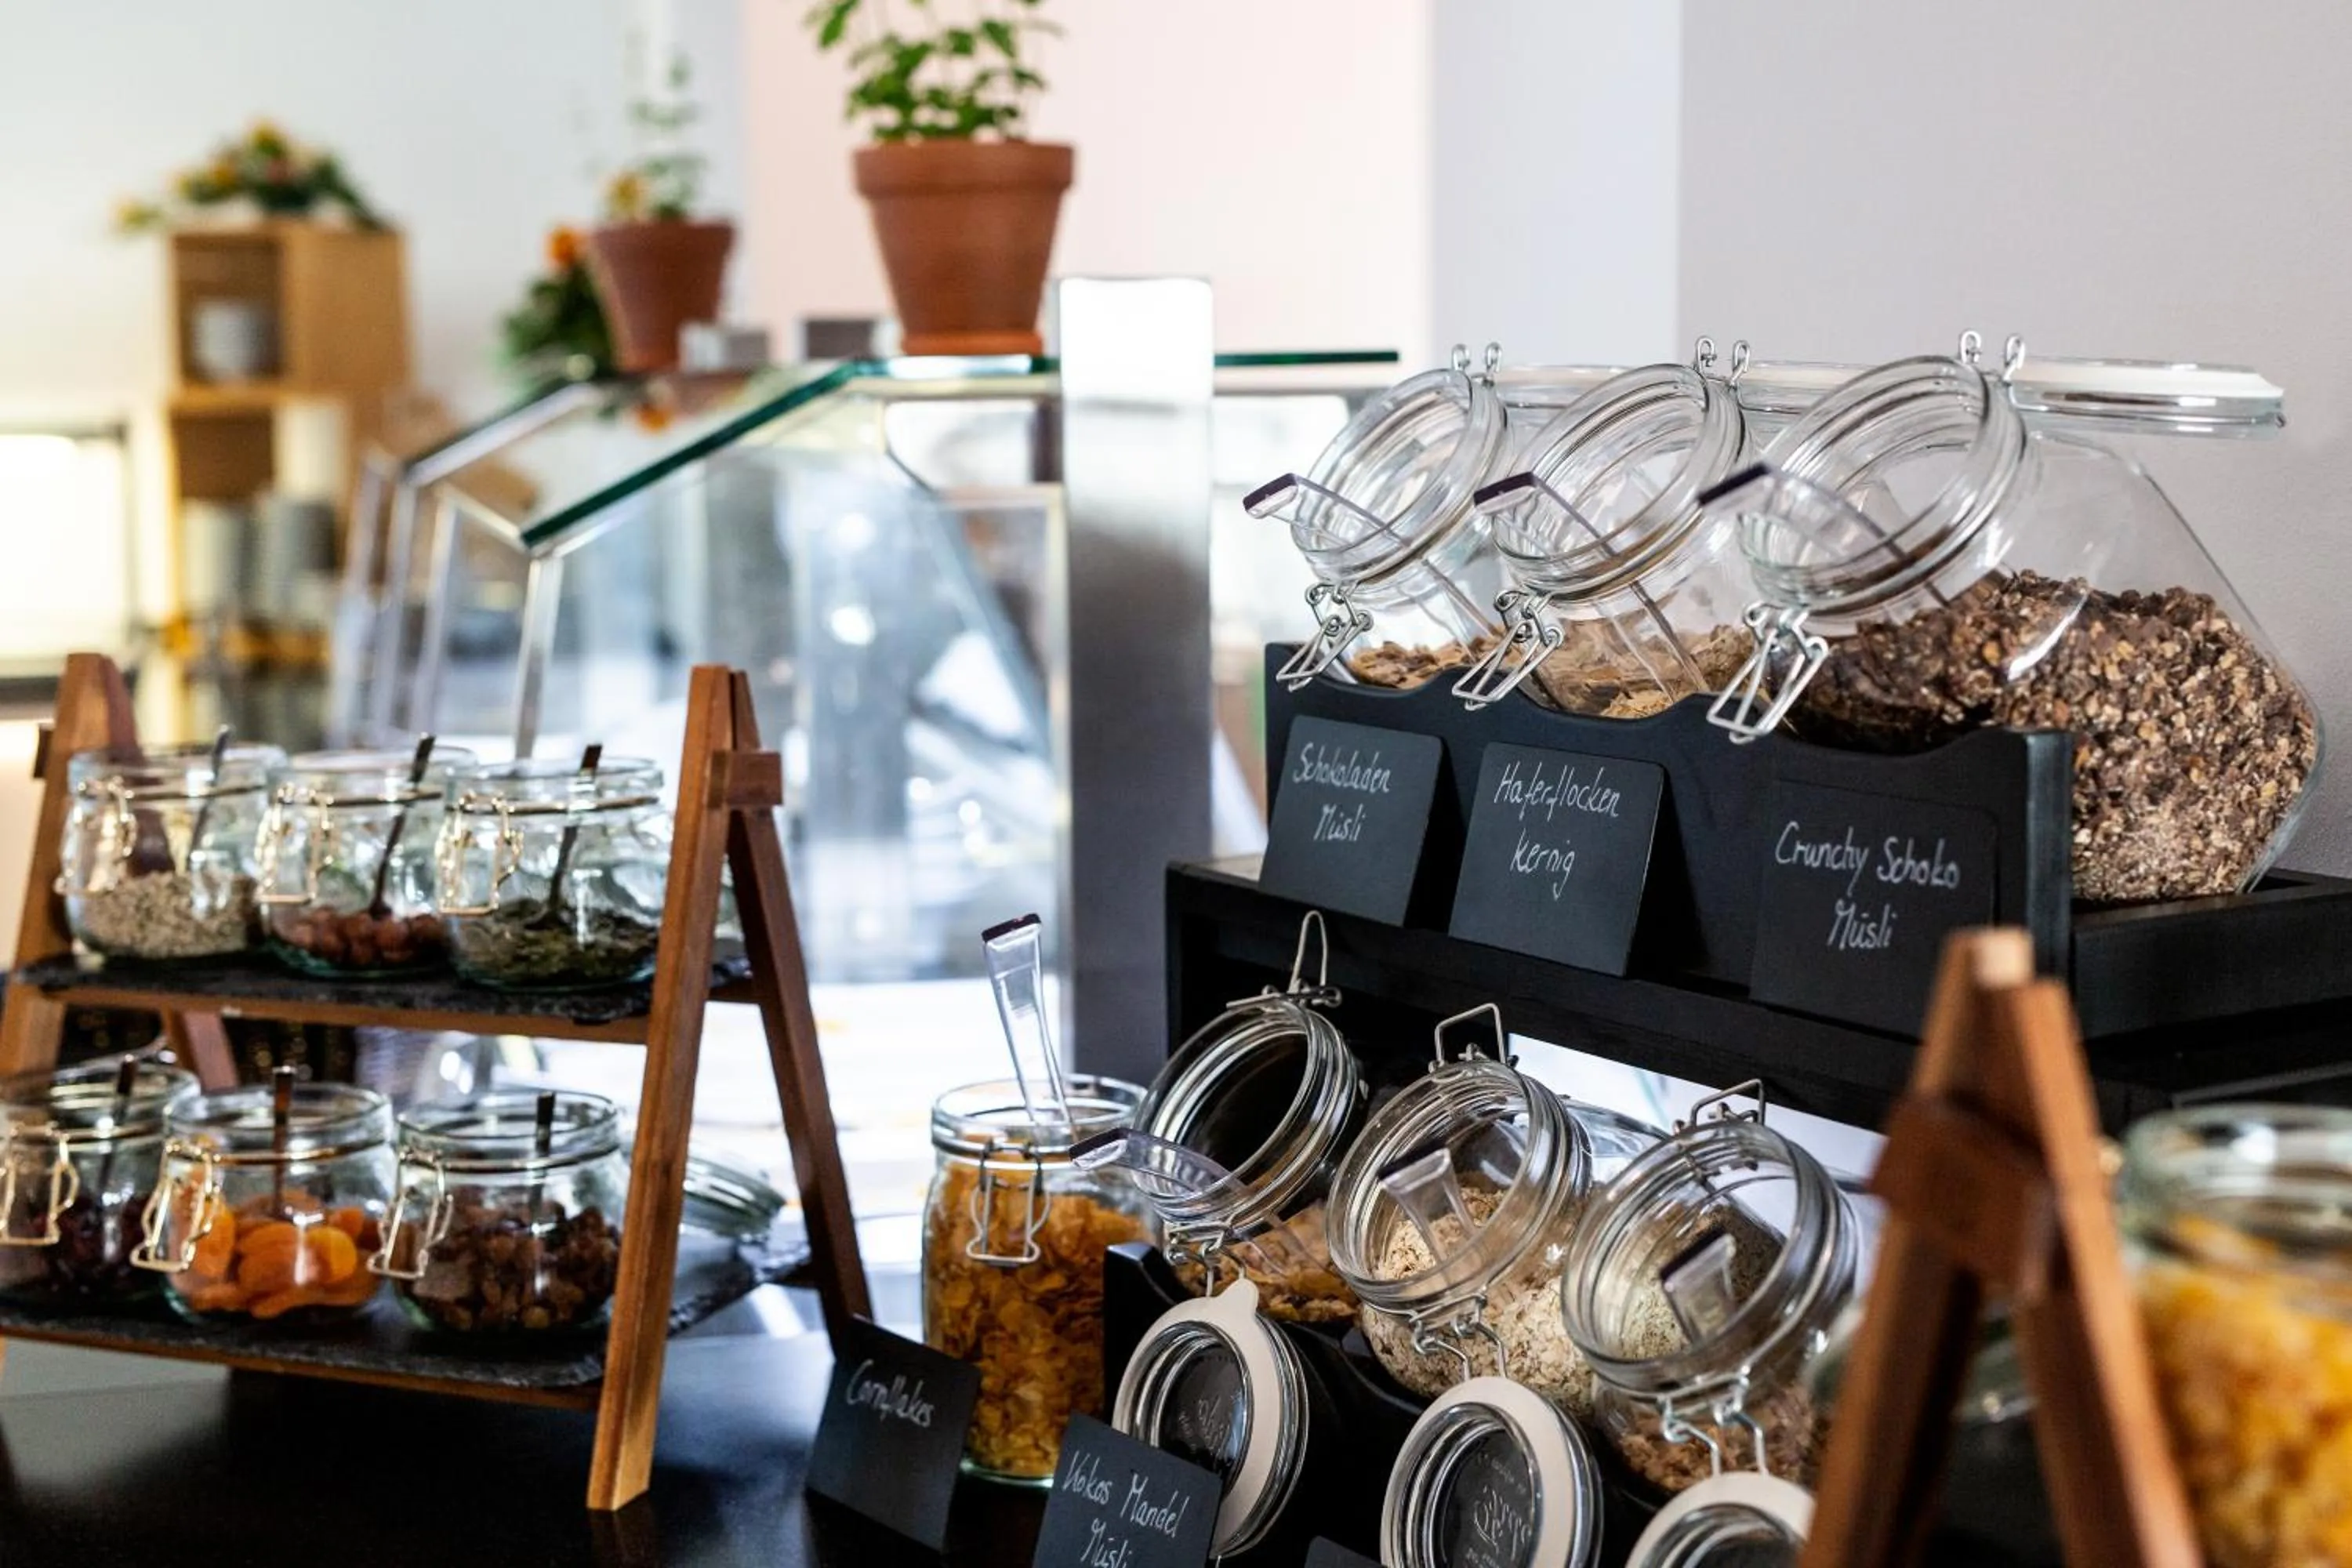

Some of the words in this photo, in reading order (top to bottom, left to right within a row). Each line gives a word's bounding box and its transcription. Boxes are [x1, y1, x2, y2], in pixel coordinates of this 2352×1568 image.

[1292, 741, 1392, 793] Schokoladen
[1494, 760, 1621, 822] Haferflocken
[1312, 802, 1367, 842] Müsli
[1774, 820, 1870, 898] Crunchy
[1876, 836, 1961, 889] Schoko
[1826, 898, 1898, 951] Müsli
[1062, 1450, 1113, 1505] Kokos
[1120, 1472, 1191, 1539] Mandel
